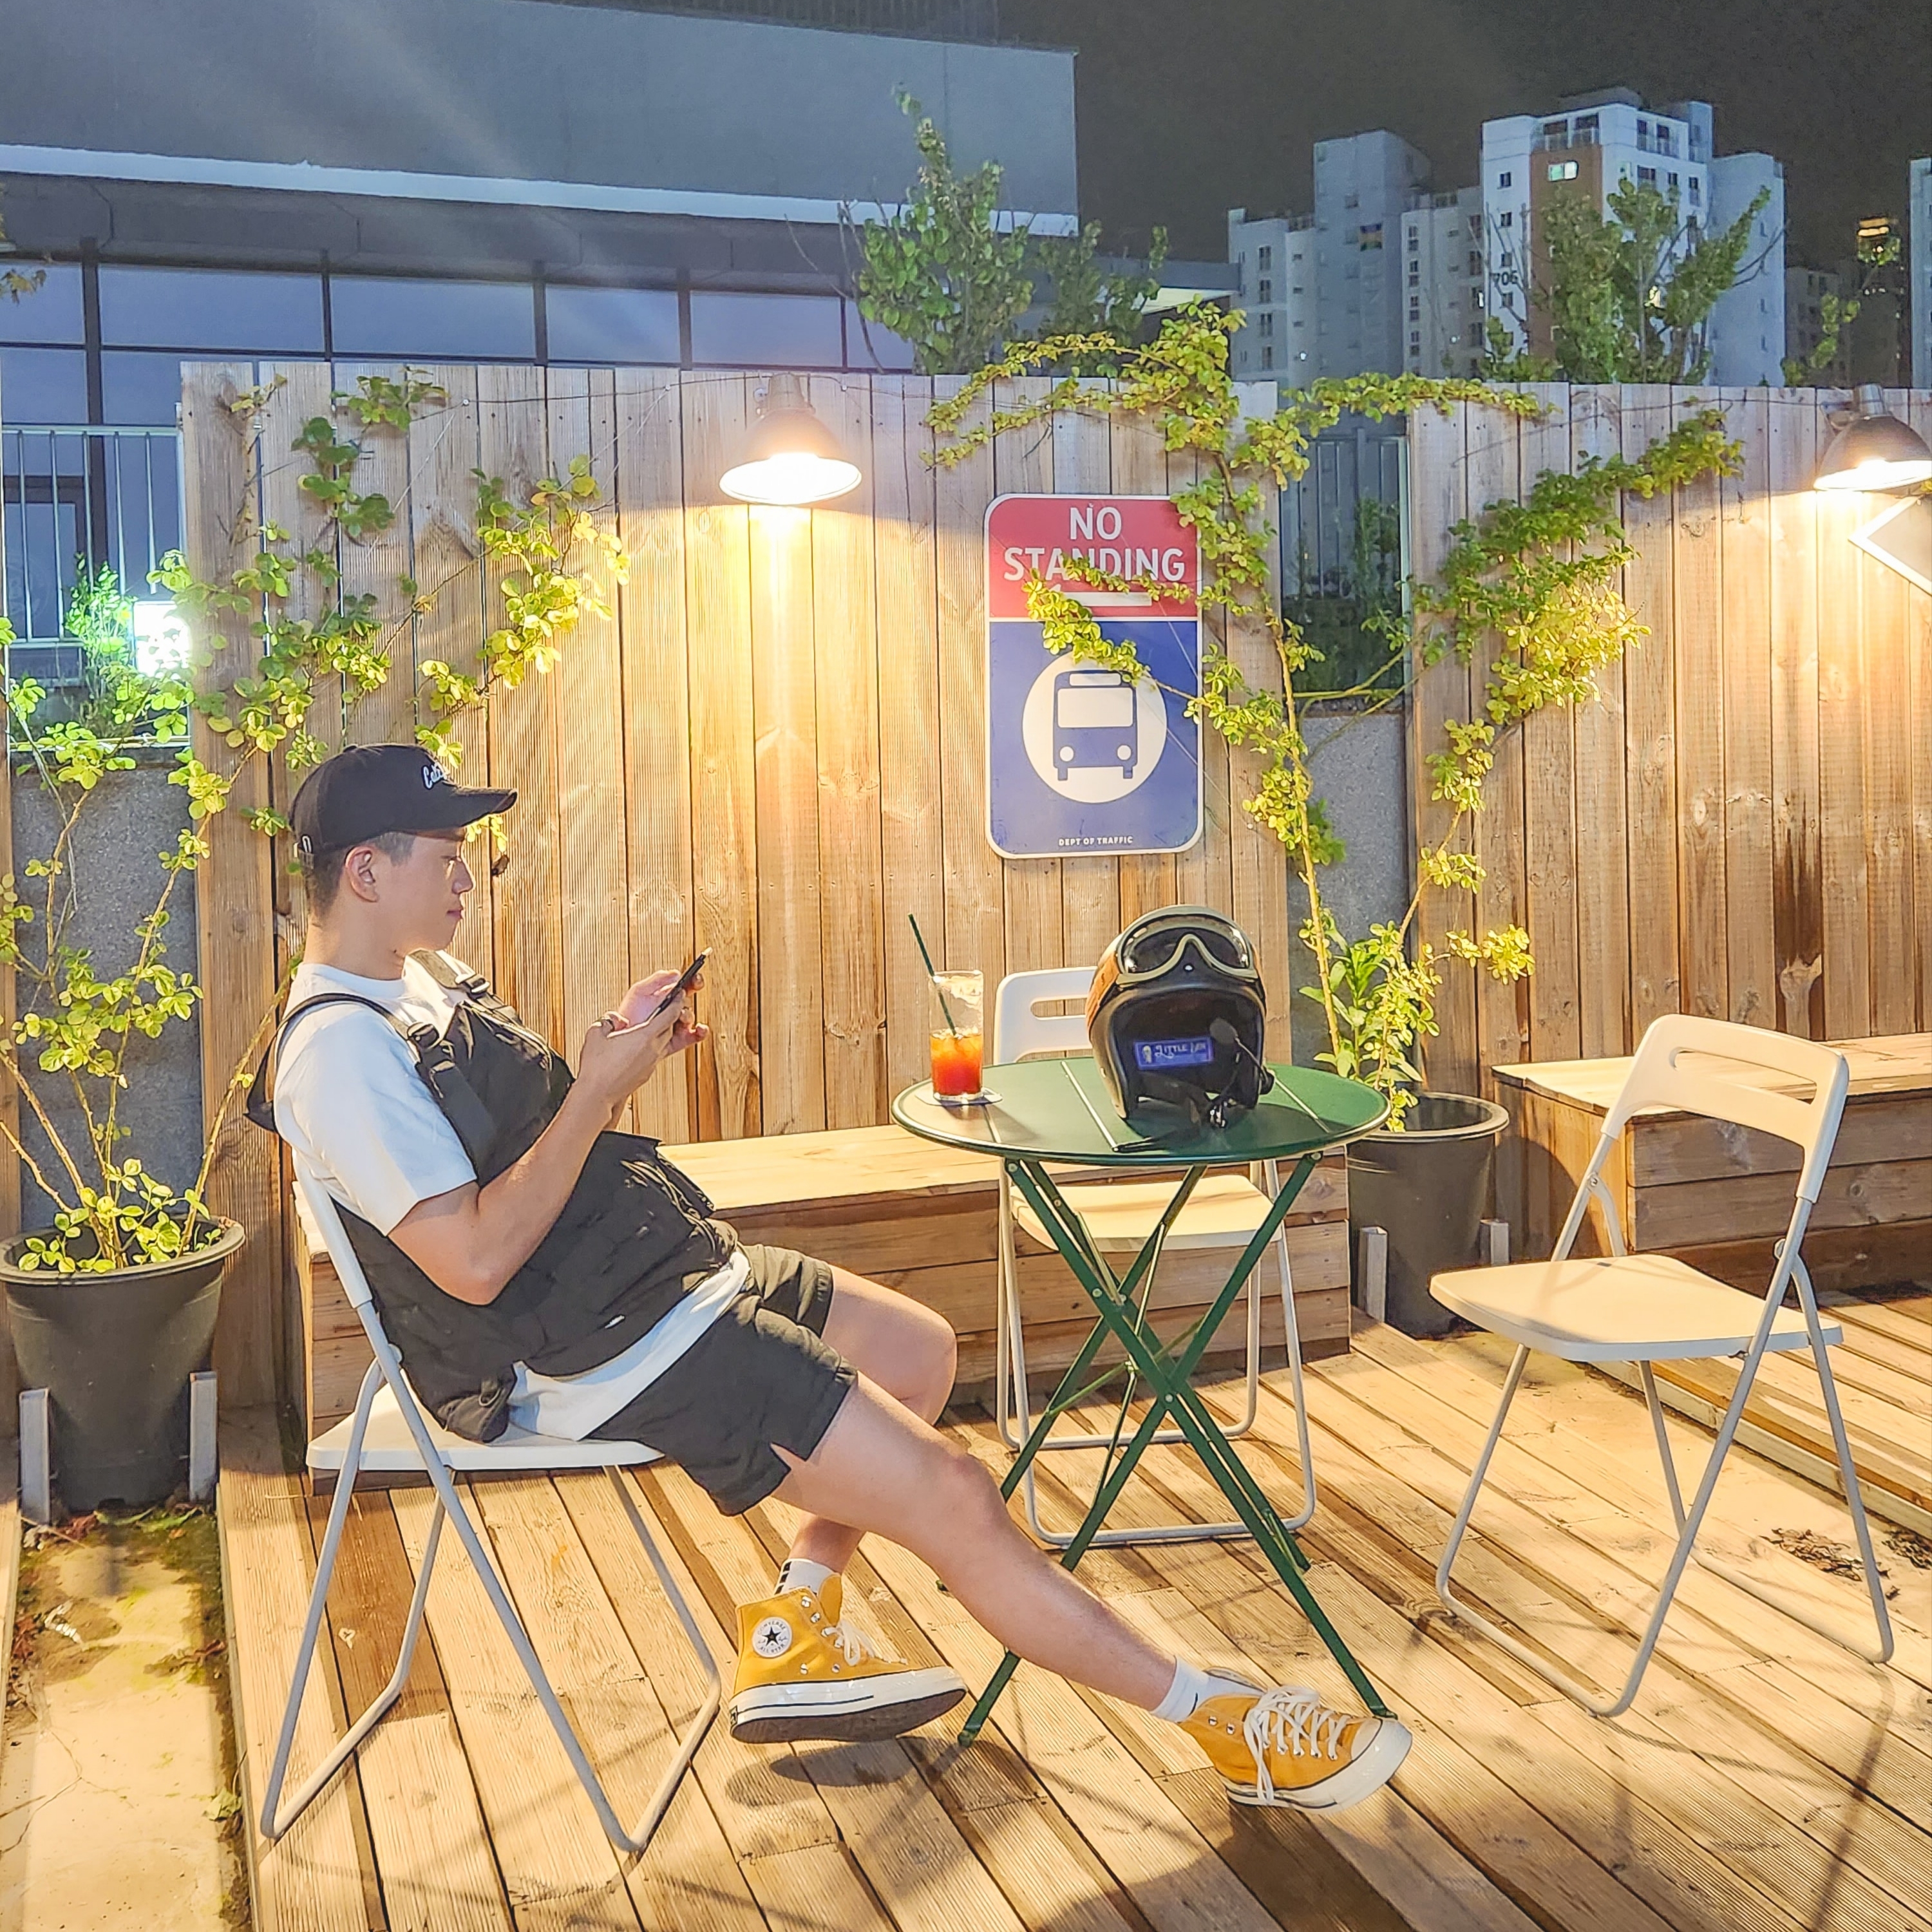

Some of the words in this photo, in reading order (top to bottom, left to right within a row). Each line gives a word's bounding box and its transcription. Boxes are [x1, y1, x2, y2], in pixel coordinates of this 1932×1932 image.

[1070, 506, 1122, 540] NO
[1058, 837, 1081, 846] DEPT
[1083, 837, 1095, 845] OF
[1097, 835, 1133, 845] TRAFFIC
